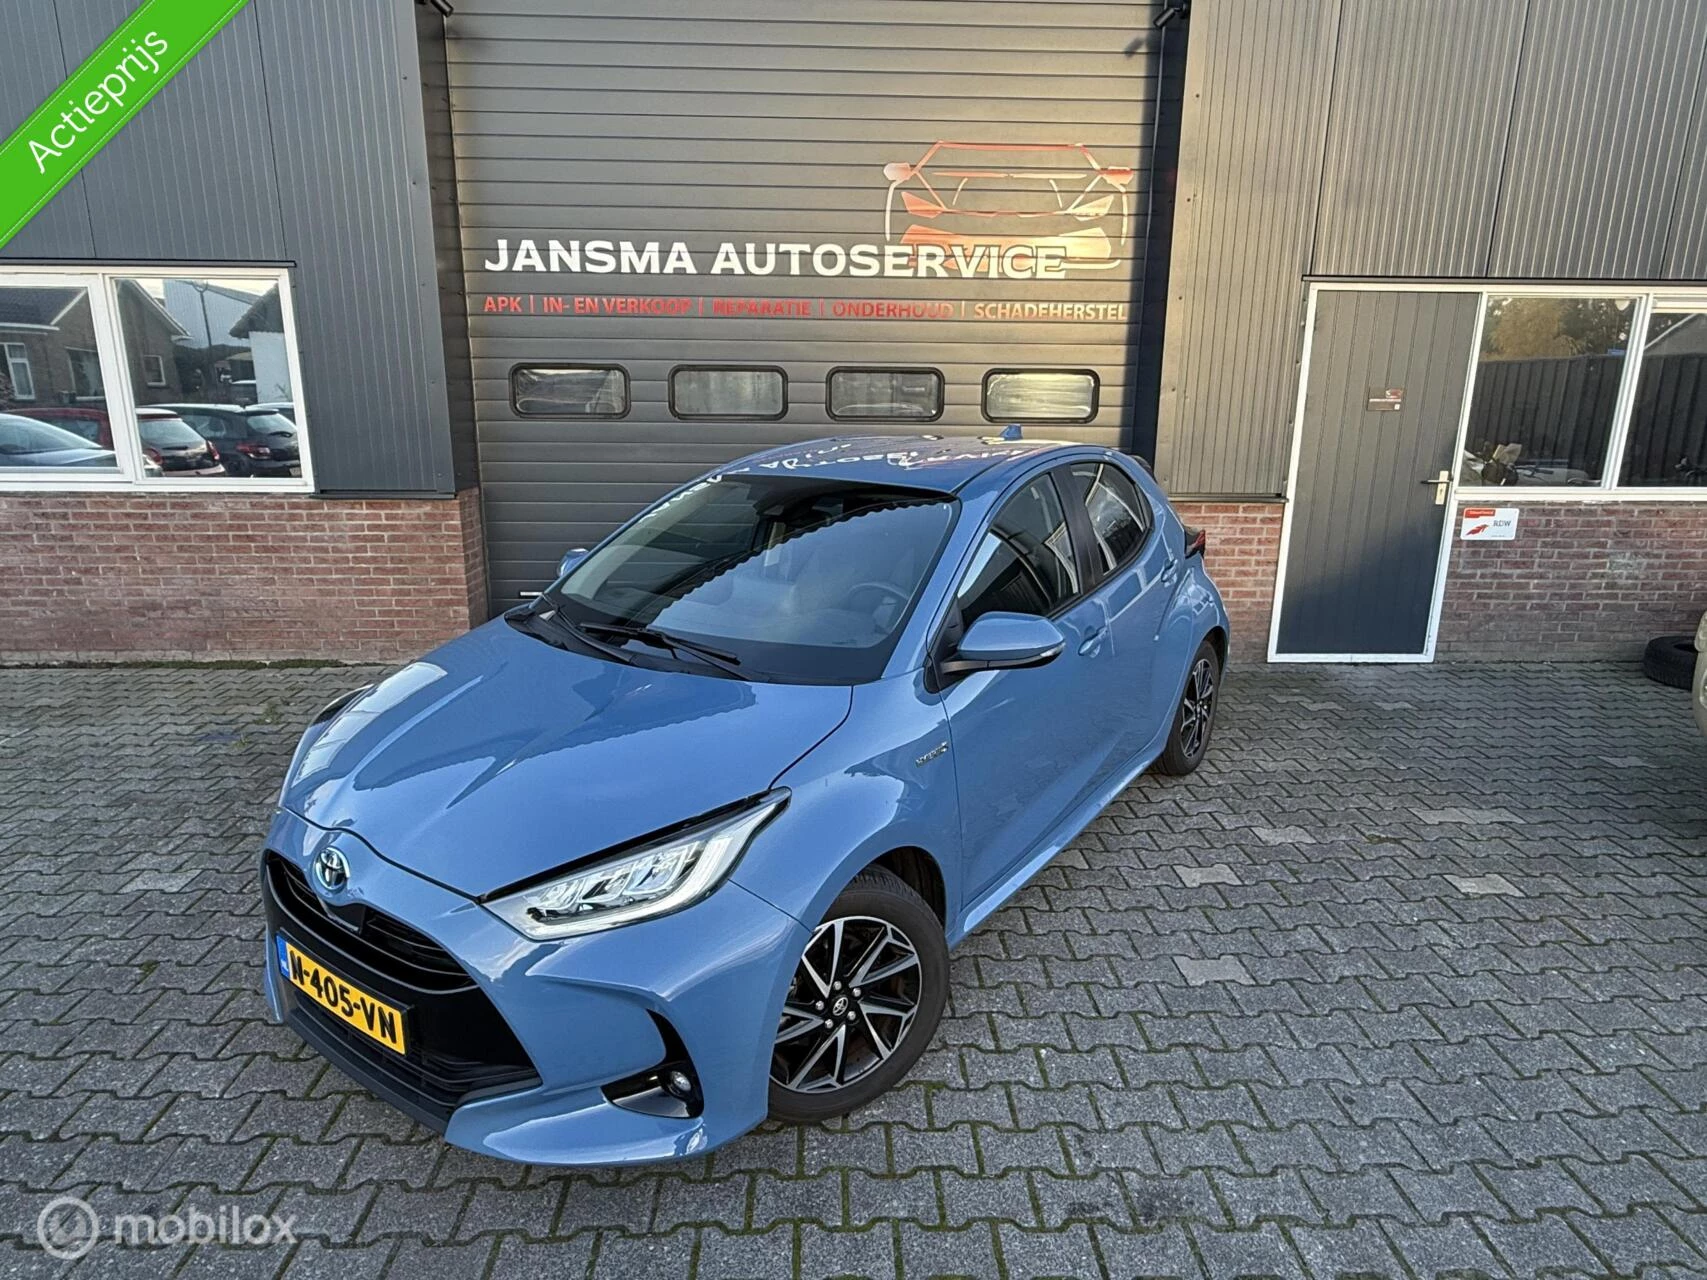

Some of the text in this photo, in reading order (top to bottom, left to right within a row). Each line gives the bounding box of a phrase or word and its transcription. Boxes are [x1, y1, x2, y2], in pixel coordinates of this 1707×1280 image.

[484, 239, 1067, 279] JANSMA AUTOSERVICE
[483, 296, 522, 313] APK
[574, 297, 598, 314] EN
[601, 297, 692, 315] VERKOOP
[712, 298, 811, 317] REPARATIE
[832, 301, 953, 319] ONDERHOUD
[974, 302, 1127, 321] SCHADEHERSTEL
[289, 949, 398, 1045] N-405-VN
